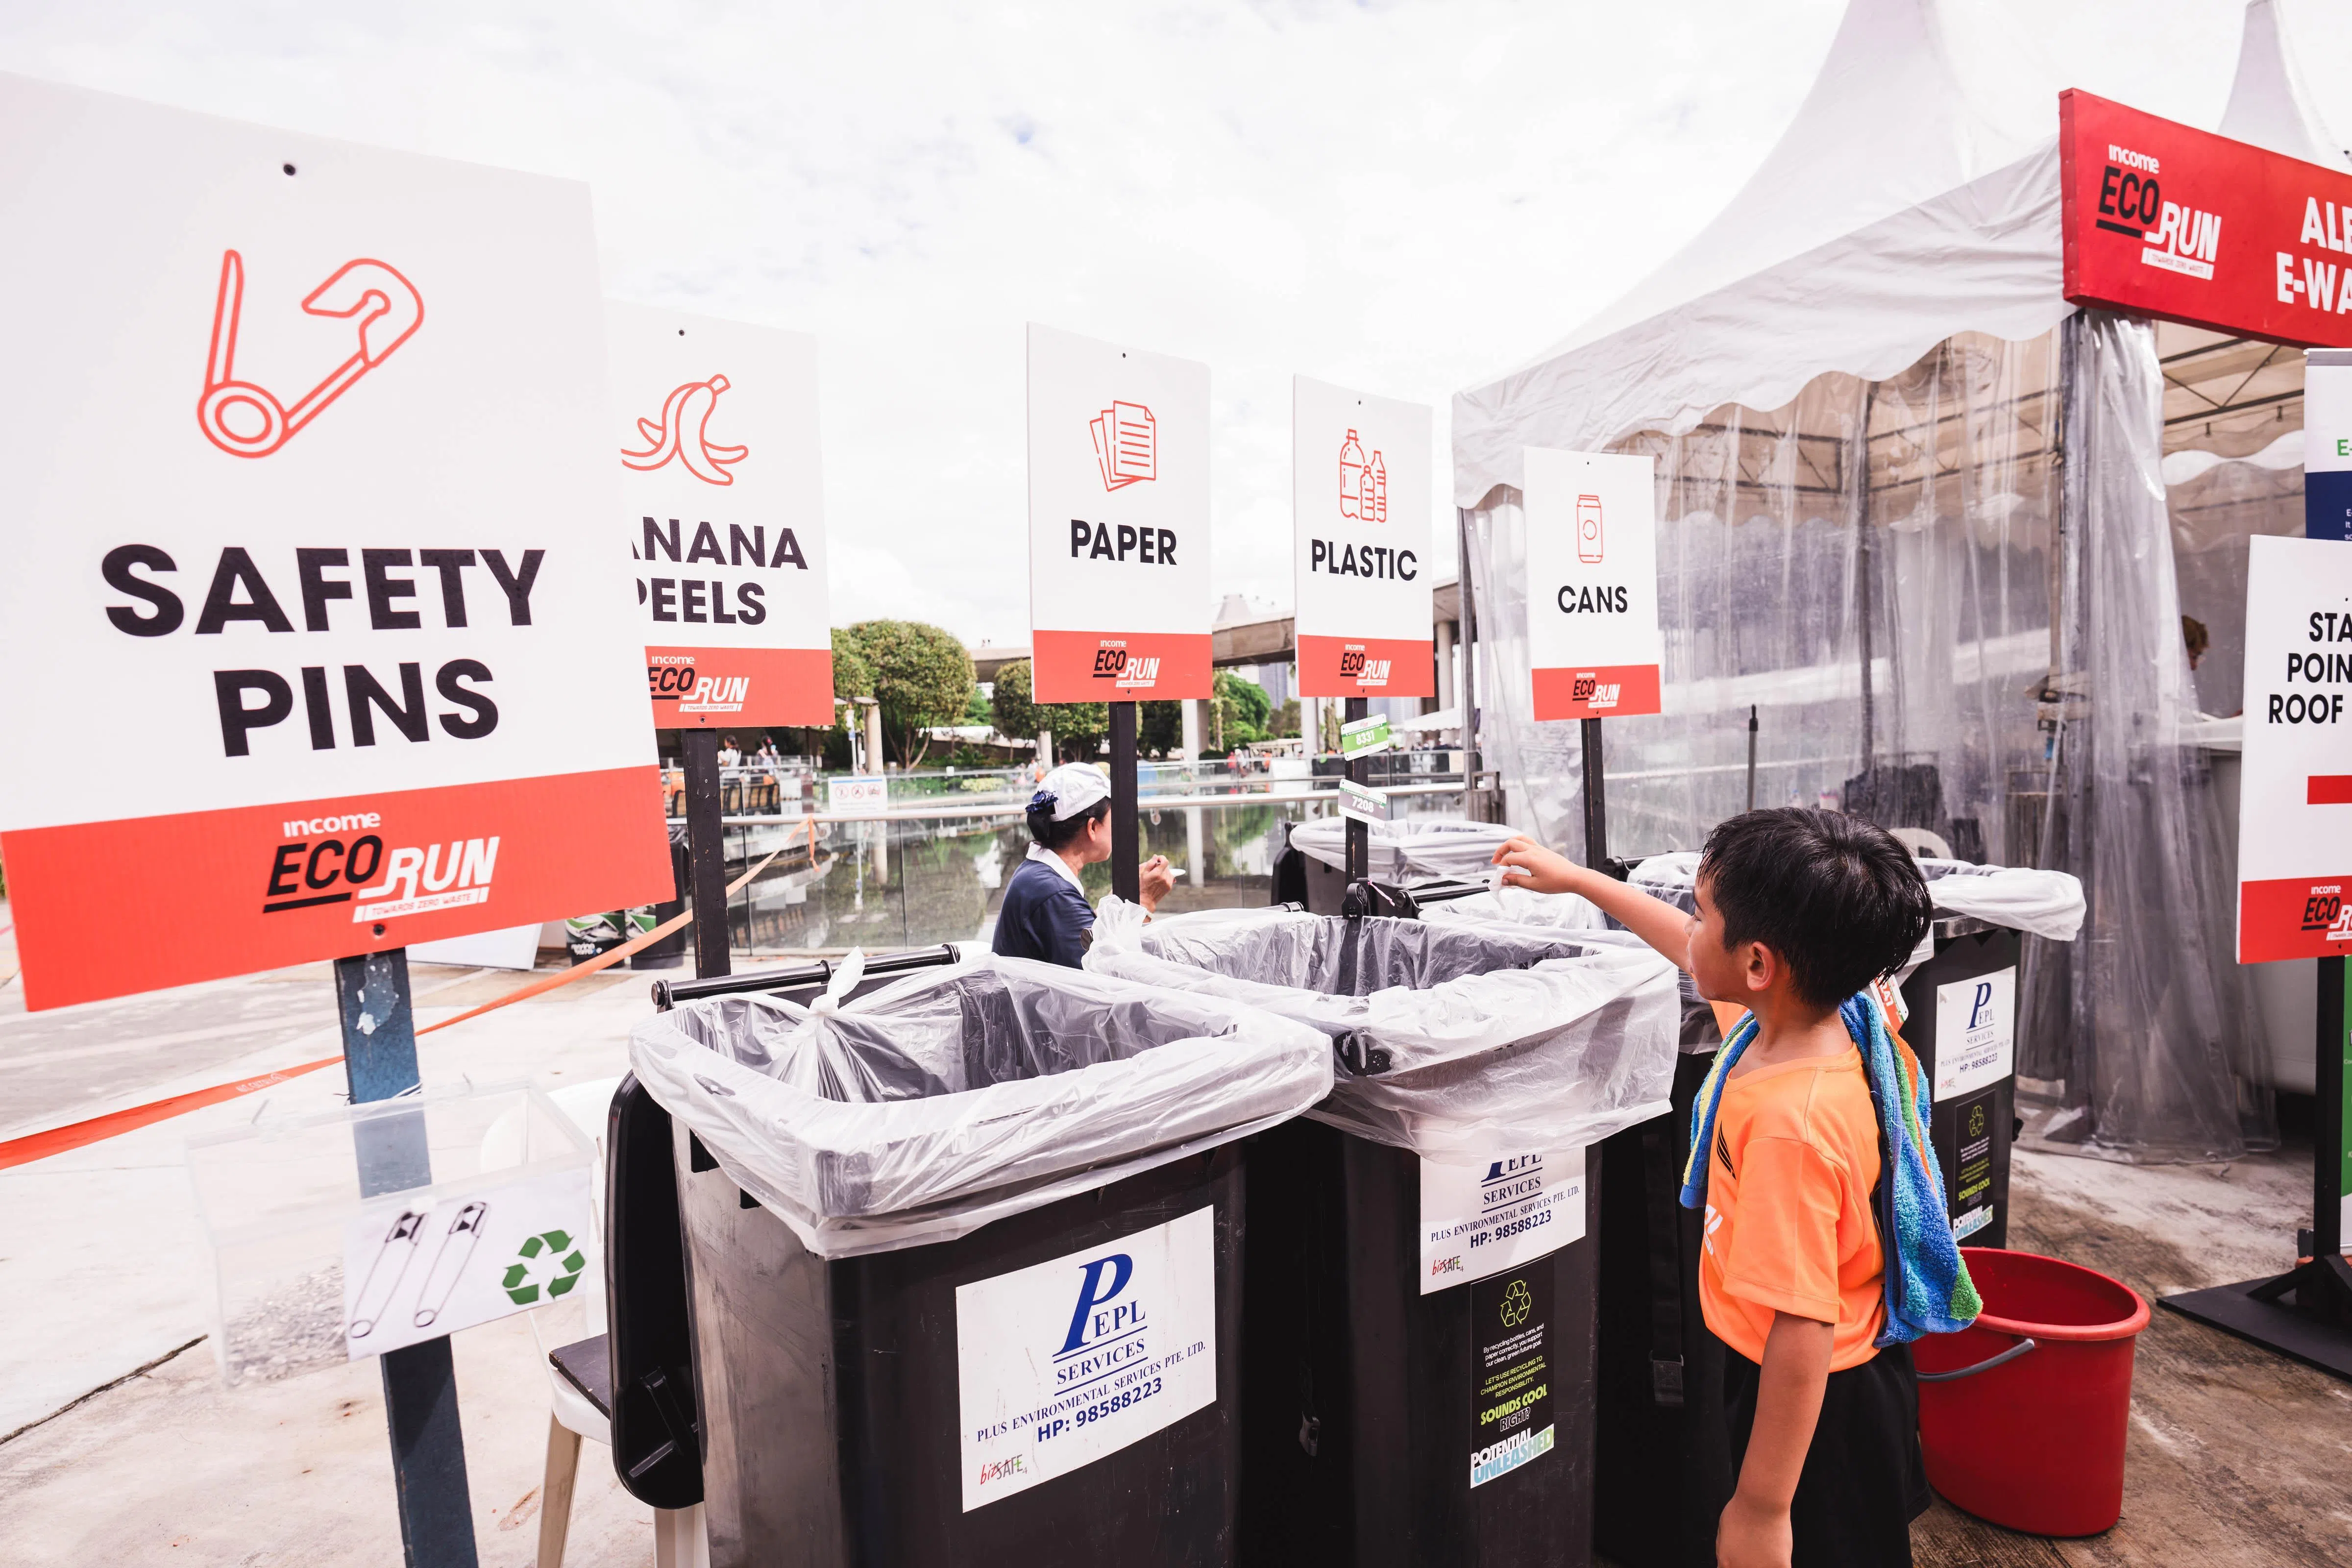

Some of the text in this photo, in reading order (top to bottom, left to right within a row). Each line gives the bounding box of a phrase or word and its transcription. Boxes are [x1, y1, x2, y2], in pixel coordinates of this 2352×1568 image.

[2108, 144, 2159, 174] income
[2098, 165, 2159, 225] ECO
[2144, 201, 2222, 262] RUN
[631, 516, 808, 569] NANA
[1071, 519, 1177, 565] PAPER
[1312, 539, 1417, 581] PLASTIC
[101, 543, 546, 637] SAFETY
[1558, 586, 1627, 613] CANS
[2309, 612, 2352, 642] STA
[1094, 650, 1127, 671] ECO
[1118, 658, 1160, 680] RUN
[1341, 653, 1365, 671] ECO
[1358, 660, 1391, 680] RUN
[2287, 653, 2352, 683] POIN
[648, 667, 695, 691] ECO
[682, 677, 750, 704] RUN
[1573, 679, 1595, 696] ECO
[1589, 684, 1620, 702] RUN
[213, 659, 499, 757] PINS
[2269, 694, 2343, 724] ROOF
[1356, 731, 1375, 745] 8331
[1352, 796, 1374, 812] 7208
[283, 812, 381, 837] income
[267, 834, 383, 897] ECO
[357, 836, 500, 901] RUN
[372, 893, 471, 916] TOWARDS ZERO WASTE
[2311, 885, 2341, 895] income
[2303, 896, 2340, 922] ECO
[2329, 905, 2352, 931] R
[1966, 982, 1994, 1029] PEPL
[1481, 1154, 1542, 1182] EPL
[1484, 1176, 1541, 1205] SERVICES
[1431, 1186, 1579, 1242] PLUS ENVIRONMENTAL SERVICES PTE. LTD.
[1470, 1210, 1551, 1249] HP: 98588223
[1052, 1253, 1146, 1357] PEPL
[1485, 1351, 1498, 1361] paper
[1499, 1343, 1519, 1355] correctly,
[1527, 1331, 1543, 1344] support
[1490, 1340, 1510, 1351] recycling
[1510, 1333, 1525, 1343] bottles,
[1525, 1328, 1536, 1336] cans,
[1494, 1356, 1507, 1364] clean,
[1507, 1349, 1519, 1360] green
[1520, 1344, 1532, 1353] future
[1533, 1339, 1542, 1349] goal.
[1057, 1338, 1145, 1385] SERVICES
[1486, 1375, 1499, 1385] LET'S
[1500, 1371, 1510, 1379] USE
[1510, 1358, 1536, 1375] RECYCLING
[977, 1341, 1205, 1442] PLUS ENVIRONMENTAL SERVICES PTE. LTD.
[1481, 1362, 1546, 1395] CHAMPION ENVIRONMENTAL
[1495, 1376, 1534, 1398] RESPONSIBILITY.
[1038, 1377, 1162, 1443] HP: 98588223
[1481, 1384, 1547, 1425] SOUNDS COOL
[1500, 1407, 1531, 1432] RIGHT?
[1470, 1427, 1531, 1469] POTENTIAL
[1474, 1428, 1554, 1484] UNLEASHED
